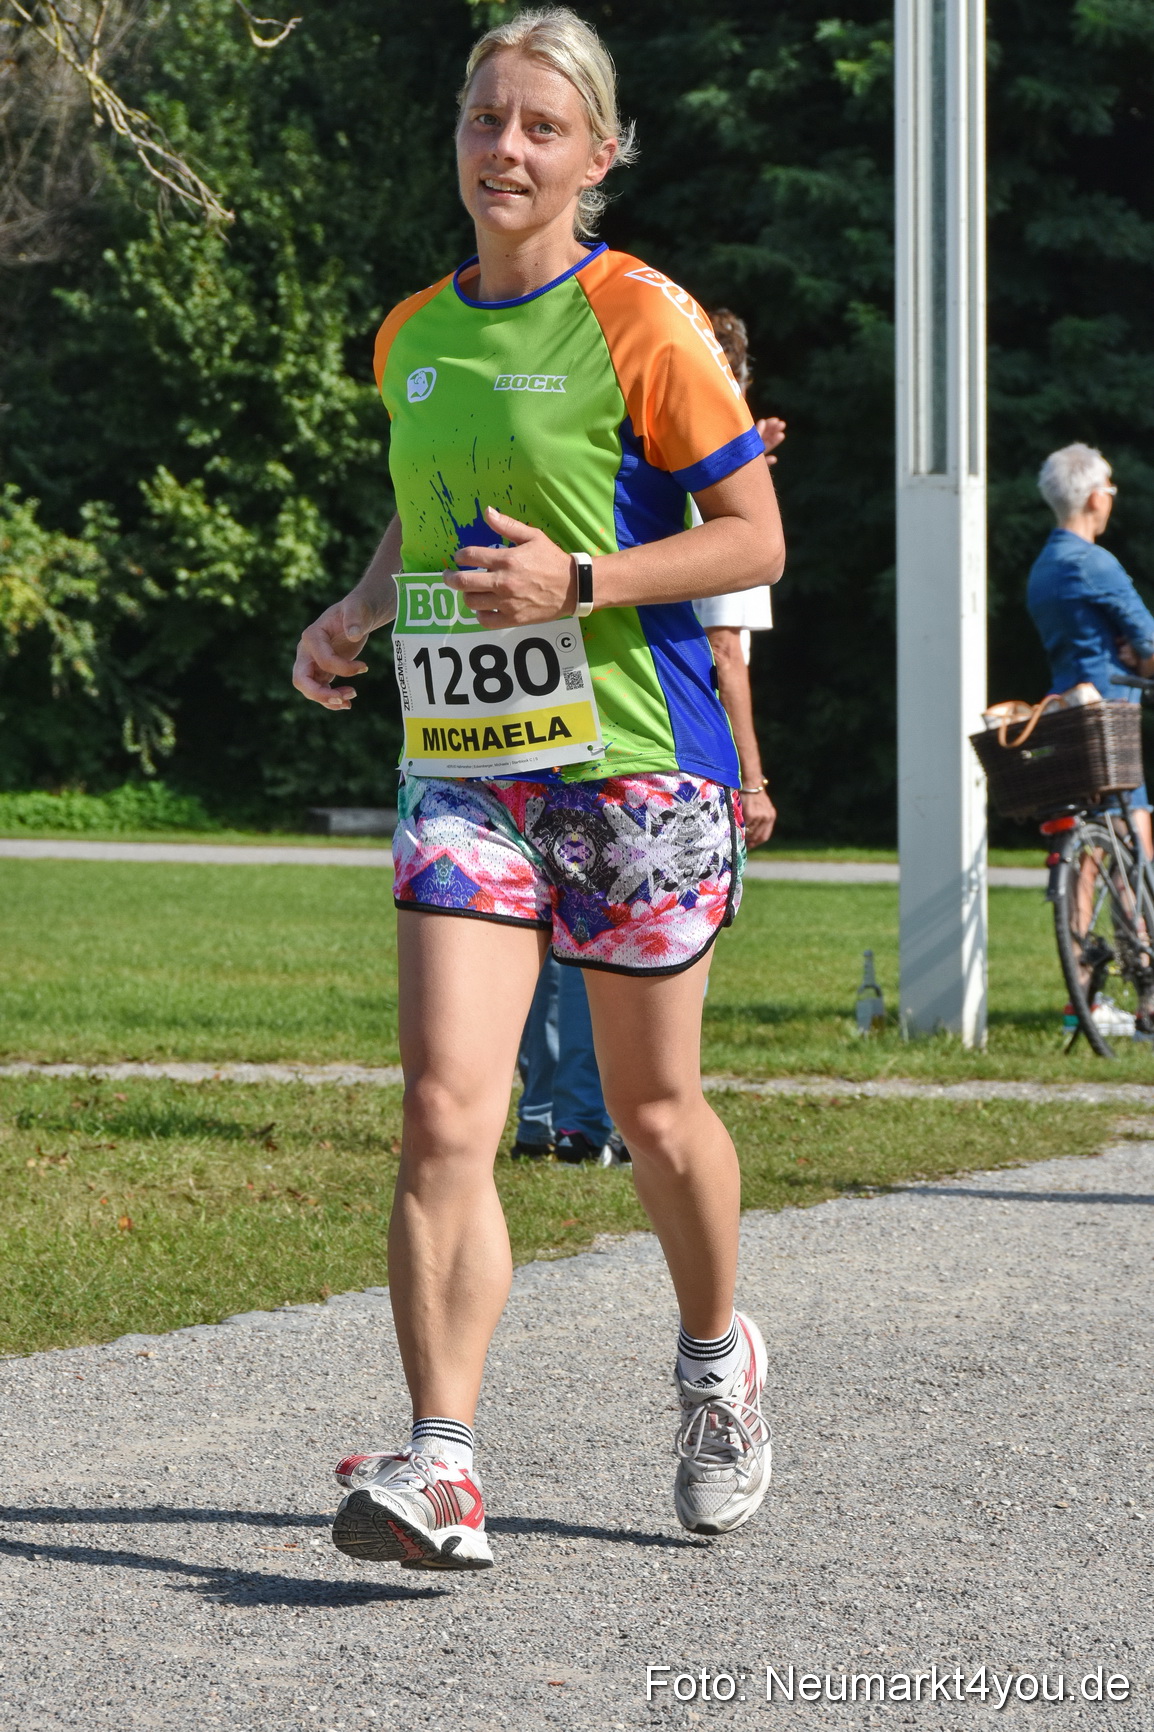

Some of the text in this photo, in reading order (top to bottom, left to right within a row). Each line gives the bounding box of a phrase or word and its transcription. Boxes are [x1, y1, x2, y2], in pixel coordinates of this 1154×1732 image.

[494, 374, 568, 393] BOCK
[405, 582, 480, 627] BO
[413, 637, 561, 705] 1280
[422, 715, 573, 752] MICHAELA
